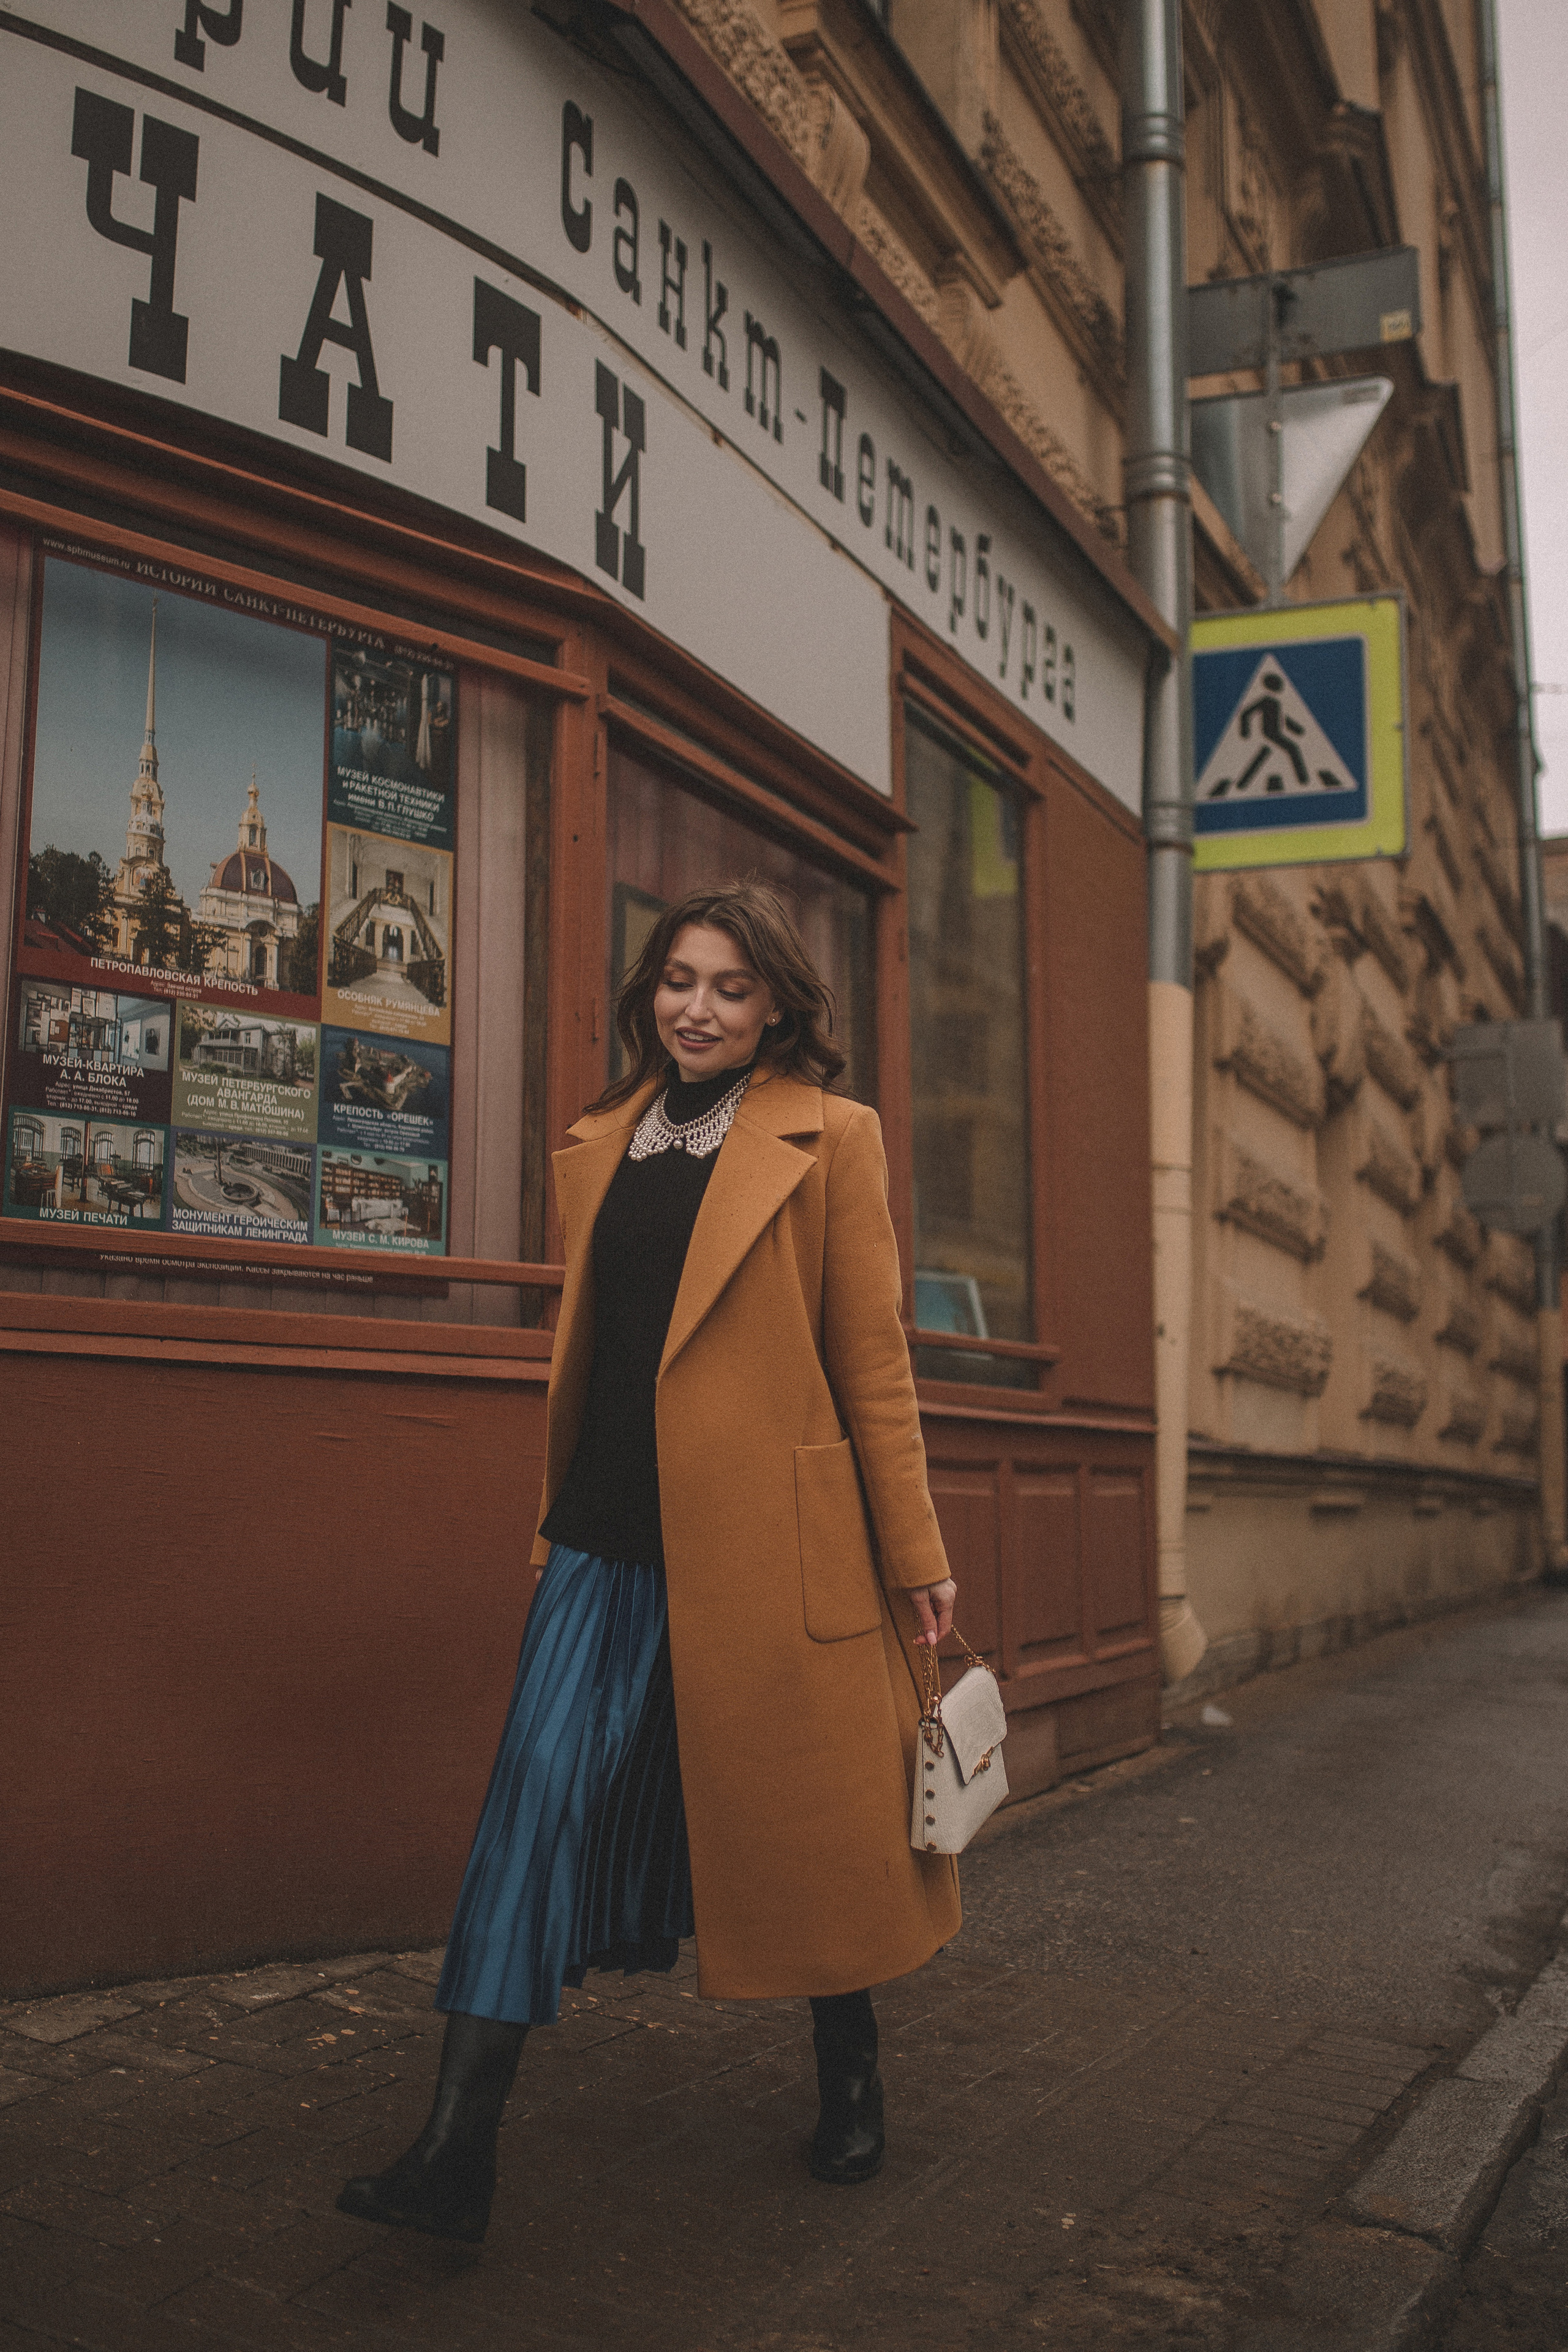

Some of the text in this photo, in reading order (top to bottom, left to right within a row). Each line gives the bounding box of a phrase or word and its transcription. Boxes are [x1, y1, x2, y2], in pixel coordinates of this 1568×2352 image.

[71, 86, 646, 601] ЧАТИ
[561, 100, 1076, 723] Санкт-Петербурга
[43, 538, 130, 570] www.spbmuseum.ru
[337, 765, 445, 804] МУЗЕЙ КОСМОНАВТИКИ
[350, 781, 398, 801] РАКЕТНОЙ
[399, 793, 440, 813] ТЕХНИКИ
[398, 804, 434, 822] ГЛУШКО
[91, 957, 258, 996] ПЕТРОПАВЛОВСКАЯ КРЕПОСТЬ
[337, 989, 383, 1006] ОСОБНЯК
[386, 998, 440, 1017] РУМЯНЦЕВА
[43, 1054, 144, 1077] МУЗЕЙ-КВАРТИРА
[60, 1069, 126, 1087] А. А. БЛОКА
[182, 1071, 311, 1099] МУЗЕЙ ПЕТЕРБУРГСКОГО
[187, 1093, 304, 1121] (ДОМ М. В. МАТЮШИНА)
[217, 1088, 277, 1105] АВАНГАРДА
[334, 1103, 383, 1120] КРЕПОСТЬ
[386, 1112, 434, 1126] «ОРЕШЕК»
[40, 1207, 127, 1226] МУЗЕЙ ПЕЧАТИ
[173, 1208, 308, 1231] МОНУМЕНТ ГЕРОИЧЕСКИМ
[172, 1220, 308, 1243] ЗАЩИТНИКАМ ЛЕНИНГРАДА
[333, 1230, 365, 1242] МУЗЕЙ
[368, 1235, 377, 1244] С.
[380, 1235, 390, 1245] М.
[392, 1236, 429, 1249] КИРОВА
[346, 1273, 374, 1283] раньше
